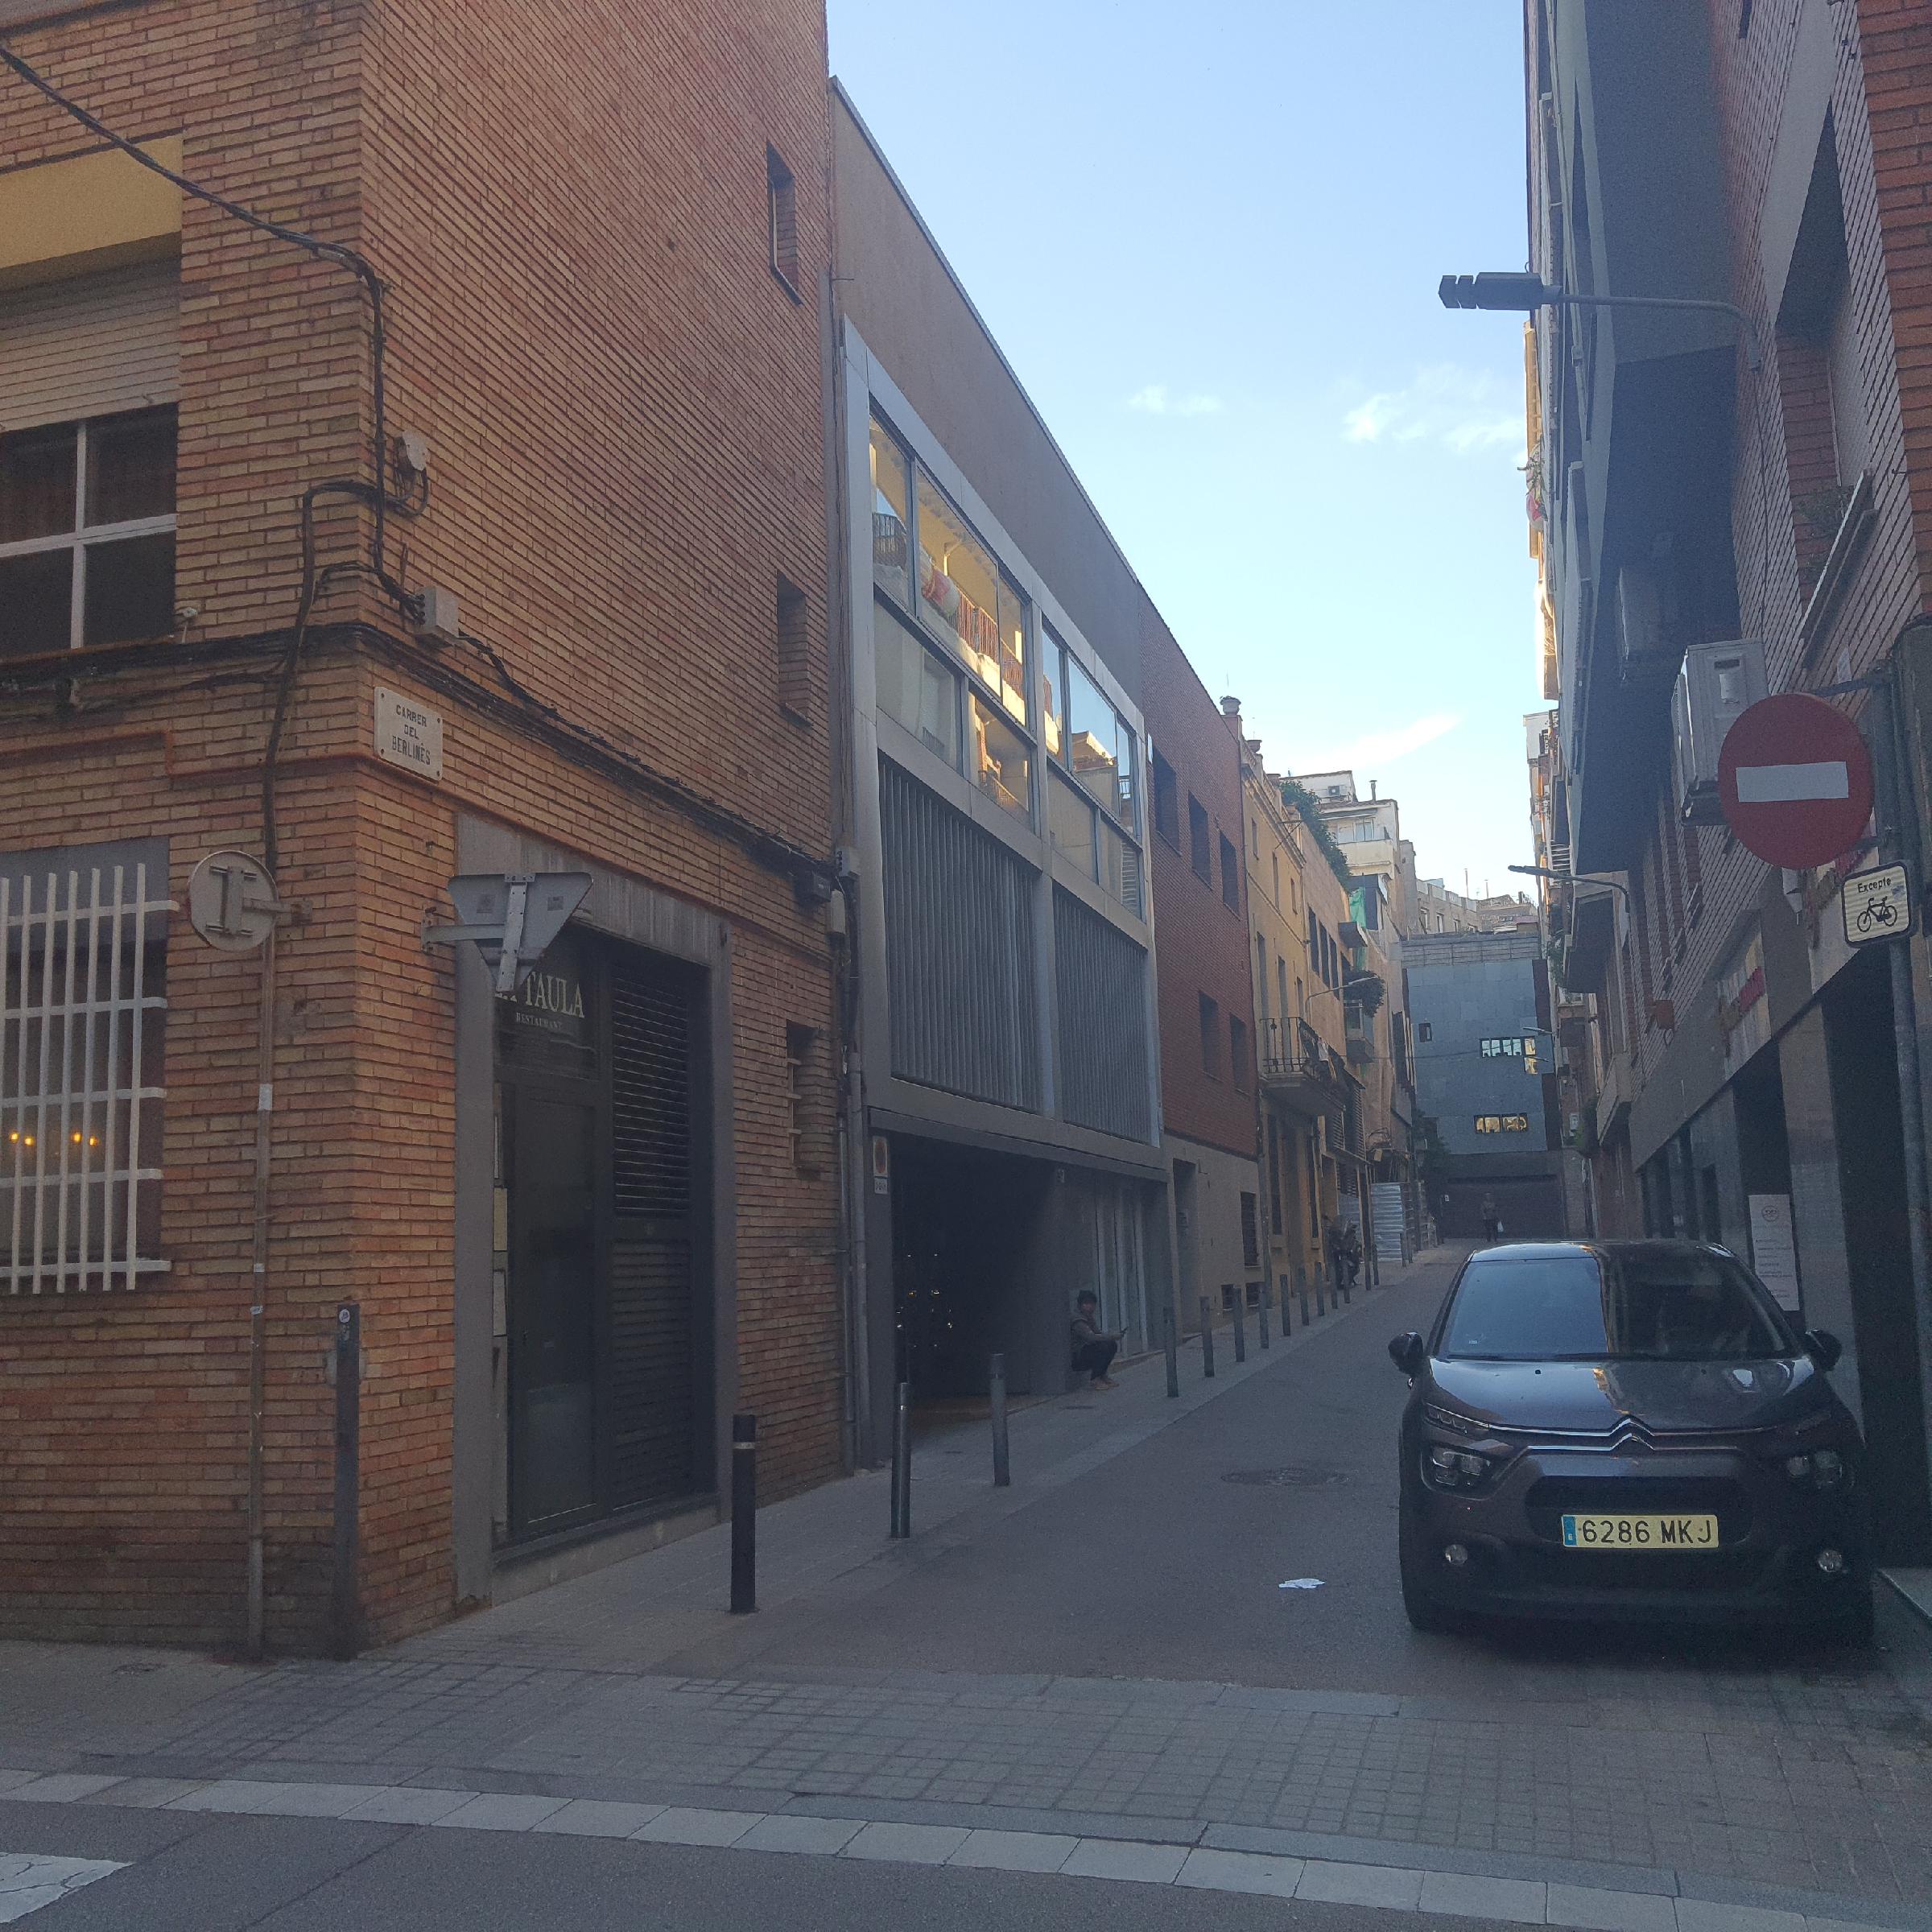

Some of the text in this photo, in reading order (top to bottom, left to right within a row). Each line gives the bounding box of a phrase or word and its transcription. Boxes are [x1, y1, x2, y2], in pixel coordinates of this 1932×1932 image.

[396, 704, 427, 727] CARRER
[403, 724, 419, 740] DEL
[1857, 877, 1892, 894] Excepte
[525, 971, 585, 1018] TAULA
[1582, 1519, 1711, 1544] 6286 MKJ
